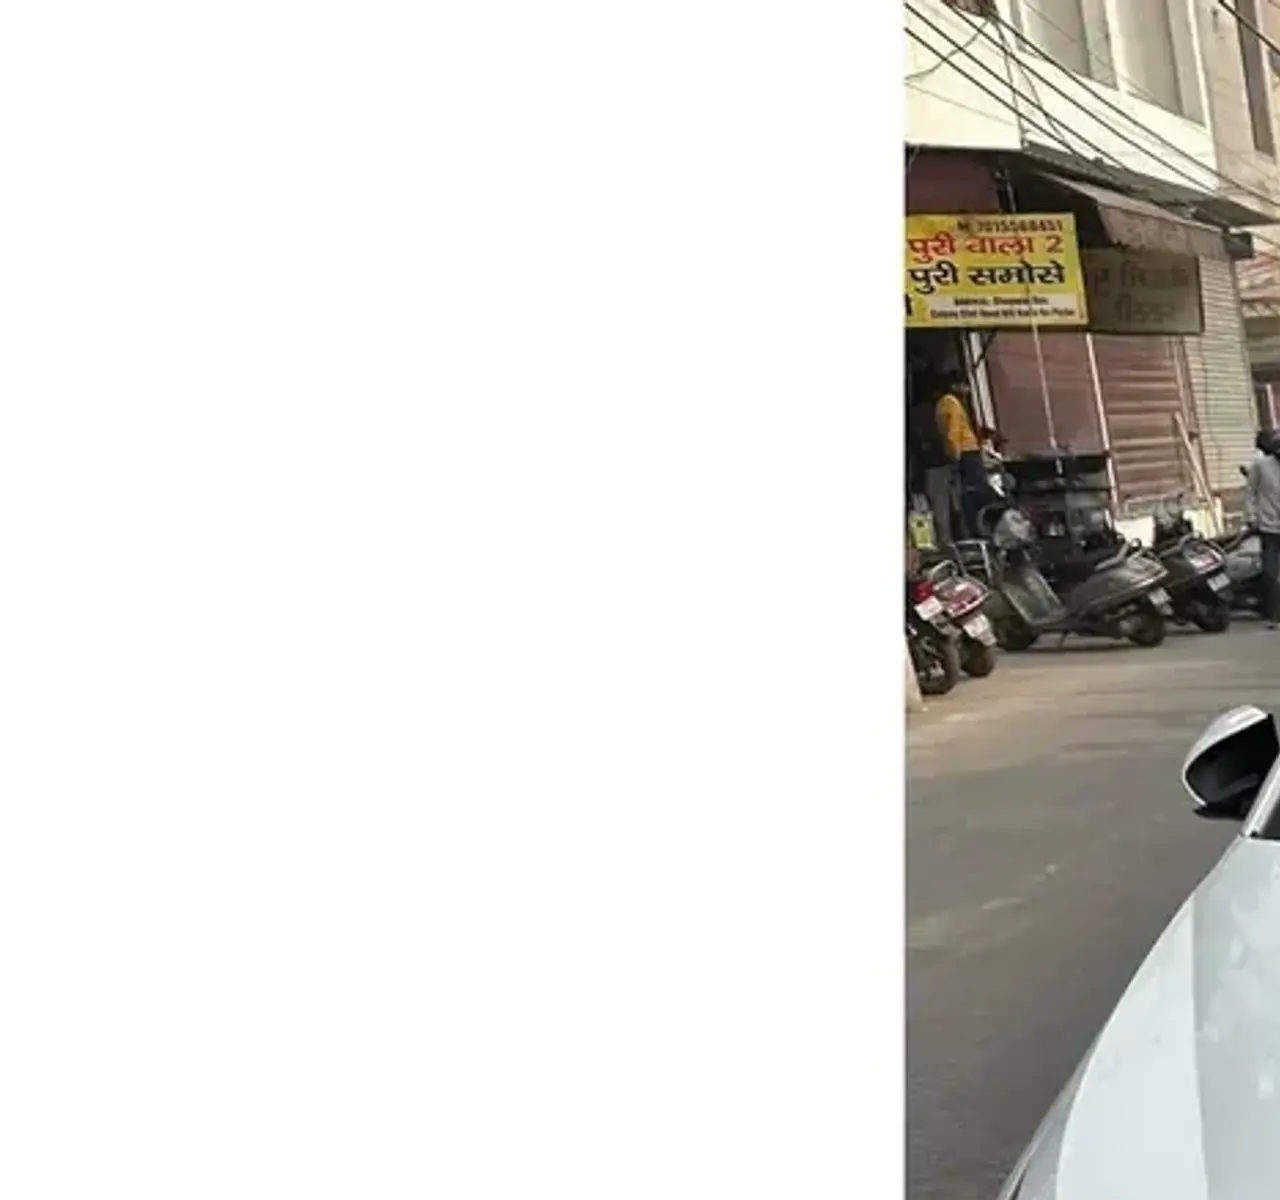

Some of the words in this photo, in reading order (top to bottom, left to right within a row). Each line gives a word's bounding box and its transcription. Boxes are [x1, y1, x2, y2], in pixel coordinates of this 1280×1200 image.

[1045, 235, 1063, 253] 2
[908, 261, 958, 294] पुरी
[967, 258, 1066, 285] समोसे
